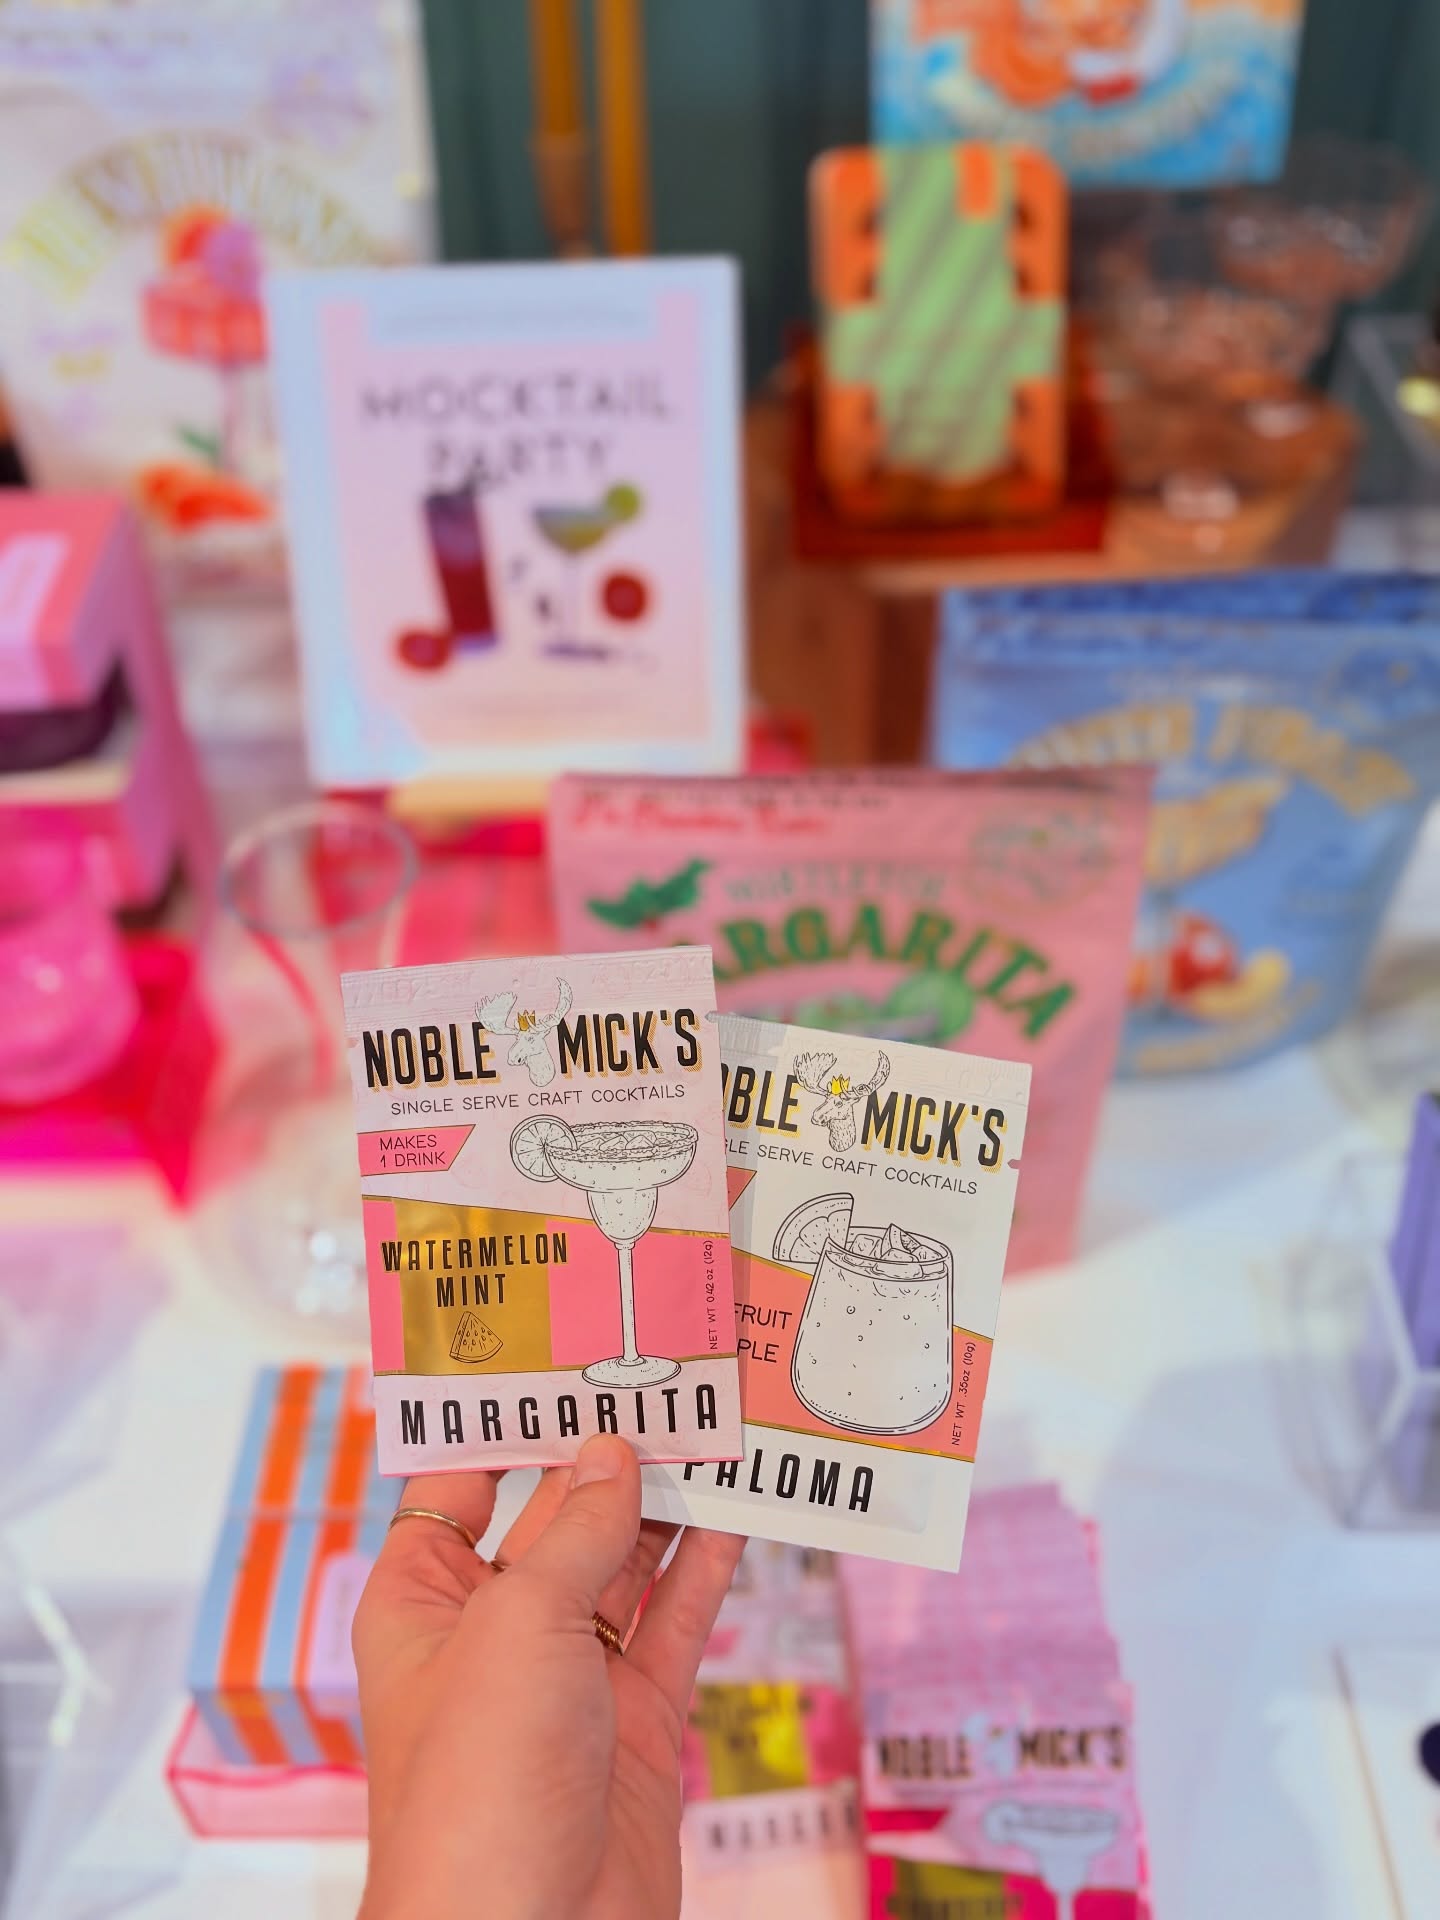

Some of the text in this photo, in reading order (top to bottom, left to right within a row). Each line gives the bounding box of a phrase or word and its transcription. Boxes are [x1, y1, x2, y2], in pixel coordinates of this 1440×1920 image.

[713, 898, 1077, 1042] RGARITA
[362, 1007, 703, 1091] NOBLE MICK'S
[391, 1084, 685, 1115] SINGLE SERVE CRAFT COCKTAILS
[379, 1133, 438, 1151] MAKES
[861, 1091, 1007, 1171] MICK'S
[380, 1150, 447, 1168] 1 DRINK
[722, 1138, 978, 1195] LE SERVE CRAFT COCKTAILS
[381, 1232, 568, 1272] WATERMELON
[703, 1240, 715, 1265] (12g)
[435, 1273, 506, 1308] MINT
[706, 1269, 715, 1281] oz
[706, 1307, 716, 1323] WT
[708, 1328, 718, 1350] NET
[737, 1338, 780, 1363] PLE
[951, 1341, 977, 1446] NET WT .35oz (10g)
[401, 1383, 718, 1445] MARGARITA
